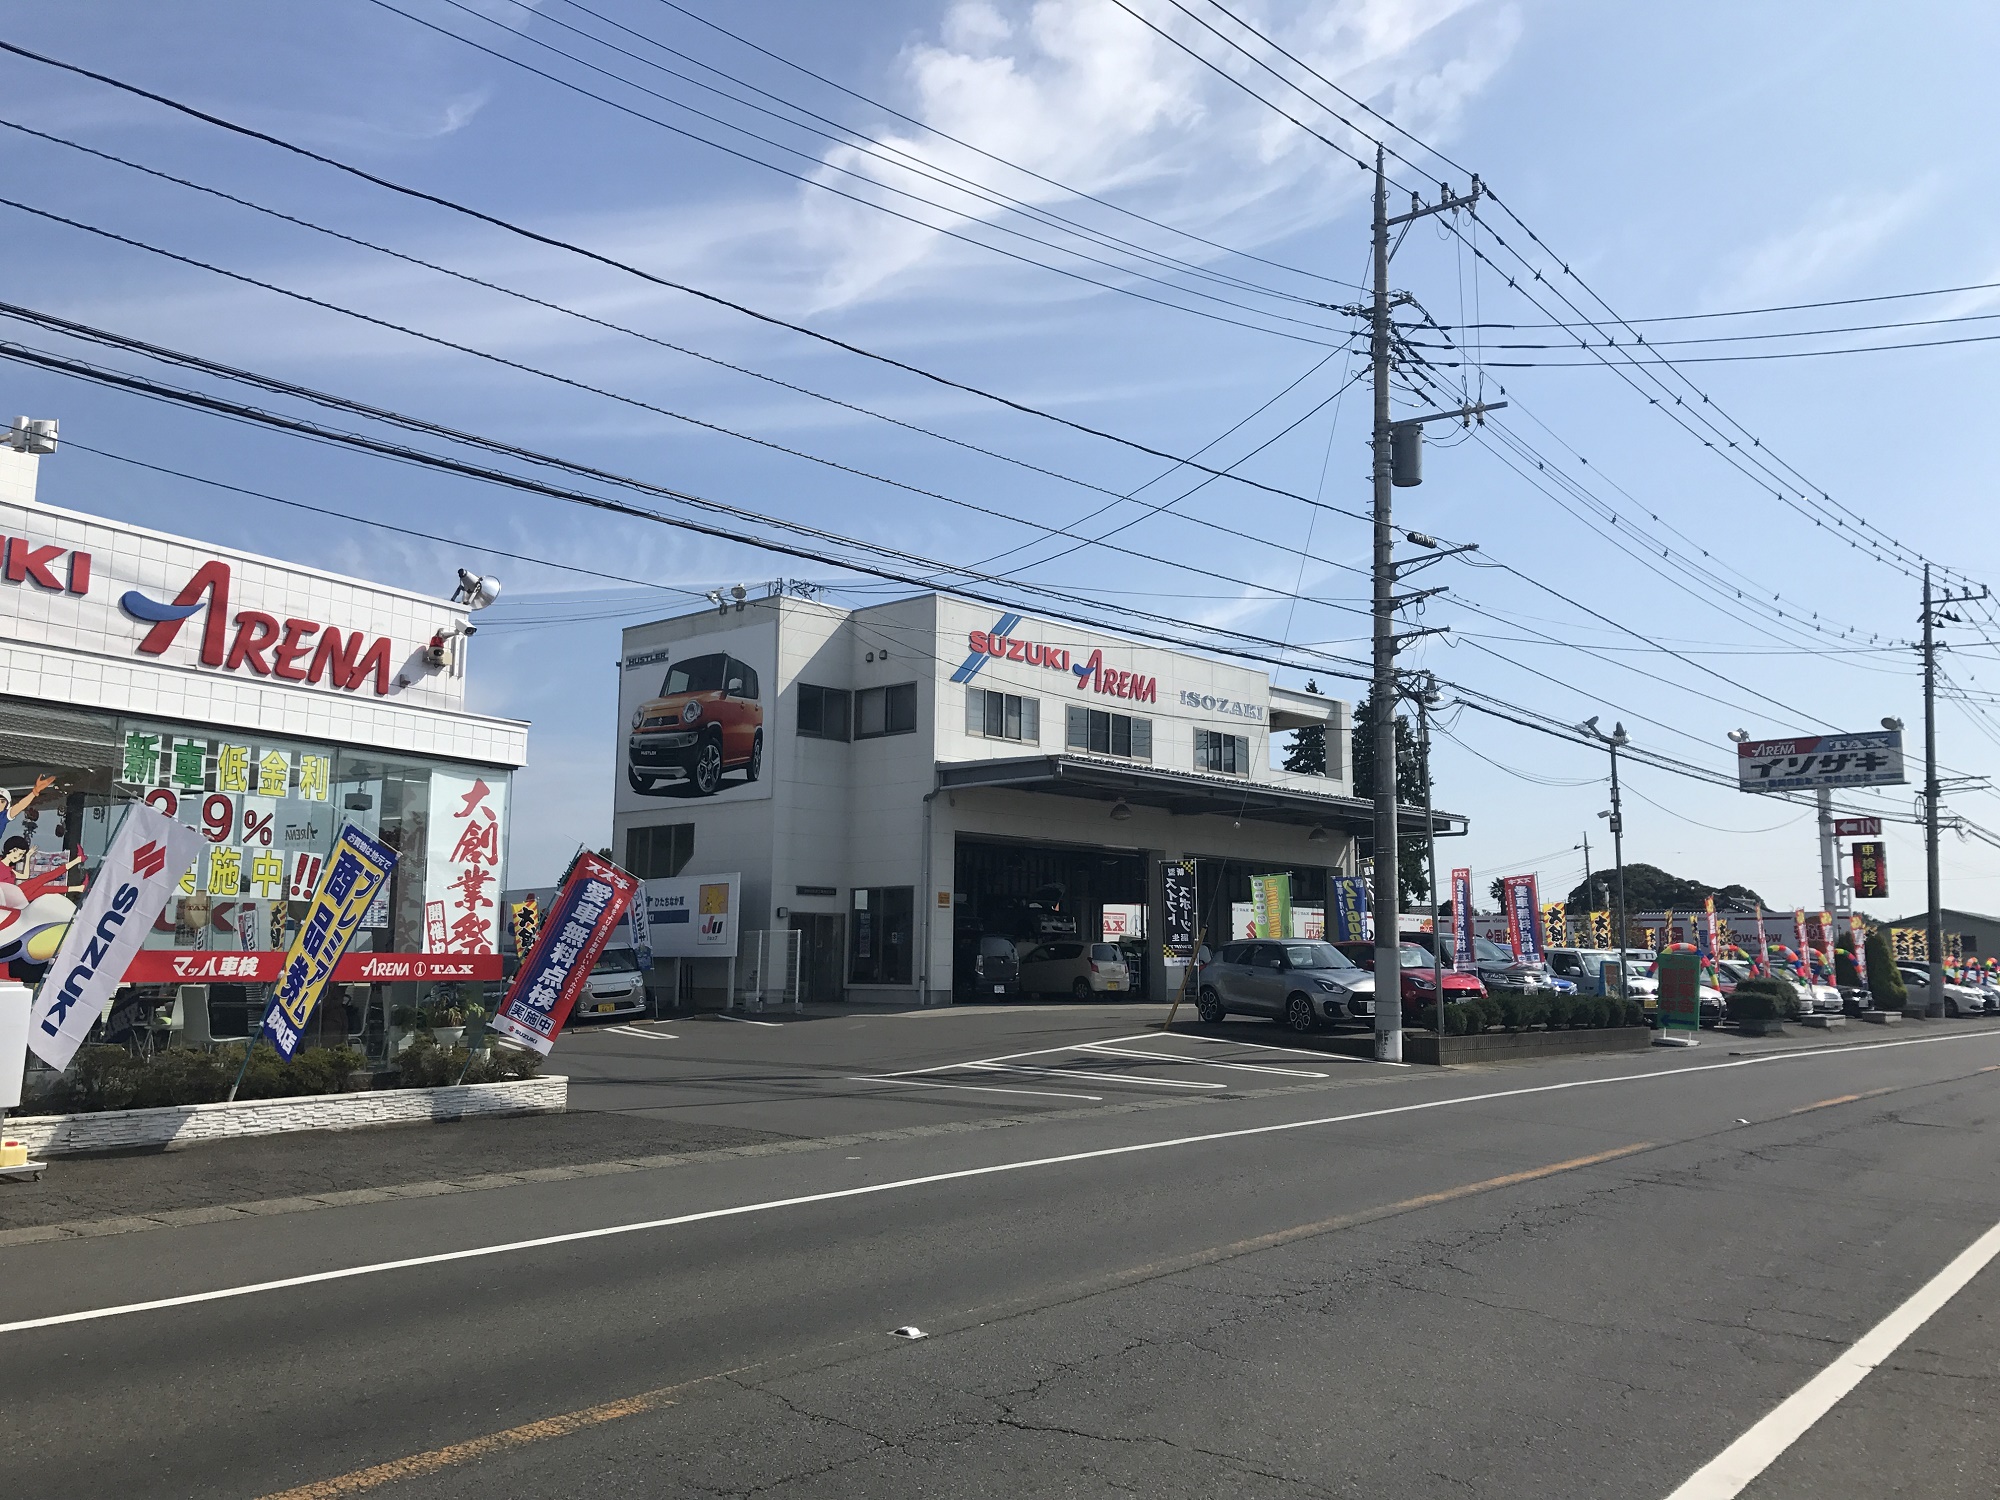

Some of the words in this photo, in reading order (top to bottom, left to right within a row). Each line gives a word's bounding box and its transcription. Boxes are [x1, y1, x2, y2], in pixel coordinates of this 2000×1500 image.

[0, 535, 91, 594] KI
[119, 560, 391, 695] ARENA
[628, 652, 666, 665] HUSTLER
[969, 630, 1069, 671] SUZUKI
[1072, 648, 1157, 703] ARENA
[1180, 690, 1263, 720] ISOZAKI
[1752, 743, 1796, 757] ARENA
[1829, 737, 1889, 751] TAX
[124, 732, 328, 800] 新車低金利
[1751, 752, 1888, 778] イソザキ
[1861, 820, 1879, 834] IN
[347, 832, 393, 870] お買物は地元で
[447, 778, 498, 954] 大創業祭
[585, 859, 631, 890] スズキ
[1862, 844, 1877, 896] 車検終了
[280, 848, 365, 1010] 商品券
[1103, 920, 1124, 932] AX
[40, 882, 139, 1038] SUZUKI
[292, 867, 381, 1026] プレミアム
[527, 879, 614, 1012] 愛車無料点検
[172, 956, 260, 977] マッハ車検
[360, 957, 410, 977] ARENA
[430, 964, 474, 975] TAX
[509, 1003, 553, 1035] 実施中
[514, 1028, 538, 1045] SUZUKI
